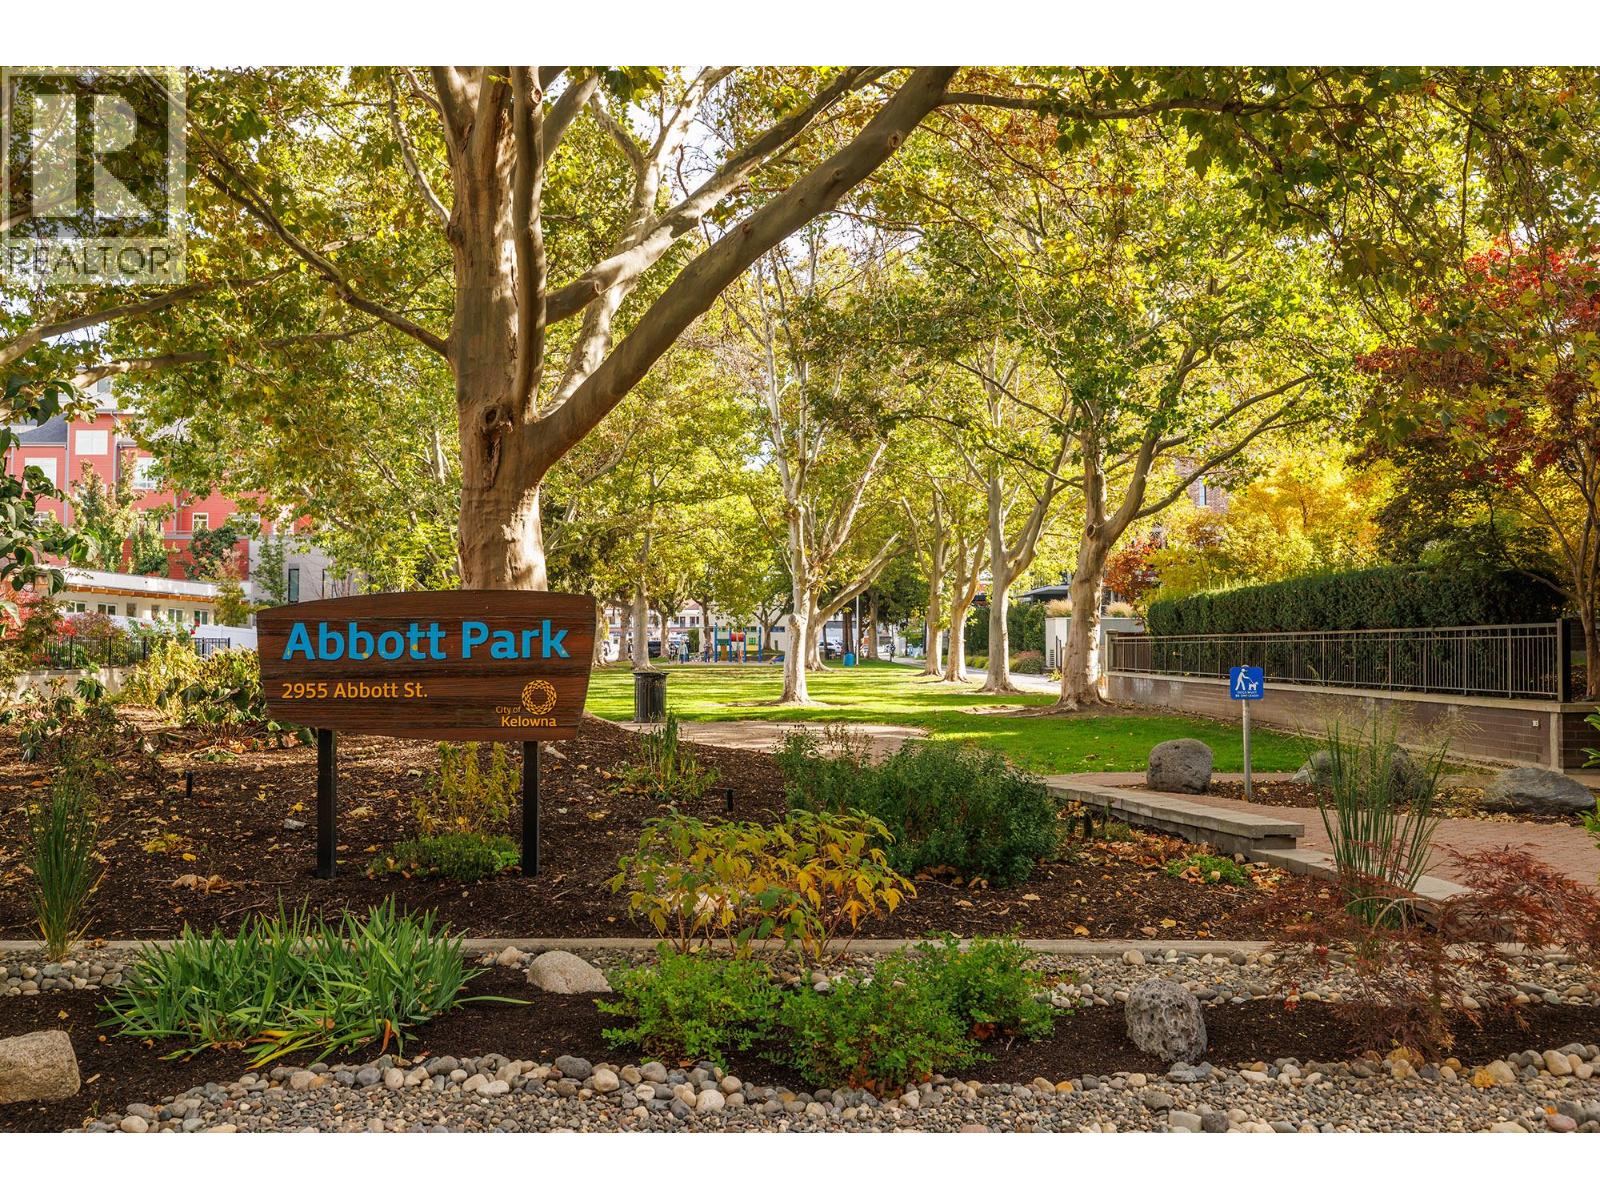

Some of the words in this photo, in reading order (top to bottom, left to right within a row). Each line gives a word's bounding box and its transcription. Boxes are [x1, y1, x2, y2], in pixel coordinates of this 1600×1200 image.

[282, 621, 447, 661] Abbott
[461, 619, 570, 660] Park
[281, 682, 328, 699] 2955
[333, 682, 399, 699] Abbott
[403, 682, 428, 698] St.
[495, 705, 511, 715] City
[512, 705, 521, 714] of
[501, 715, 558, 727] Kelowna
